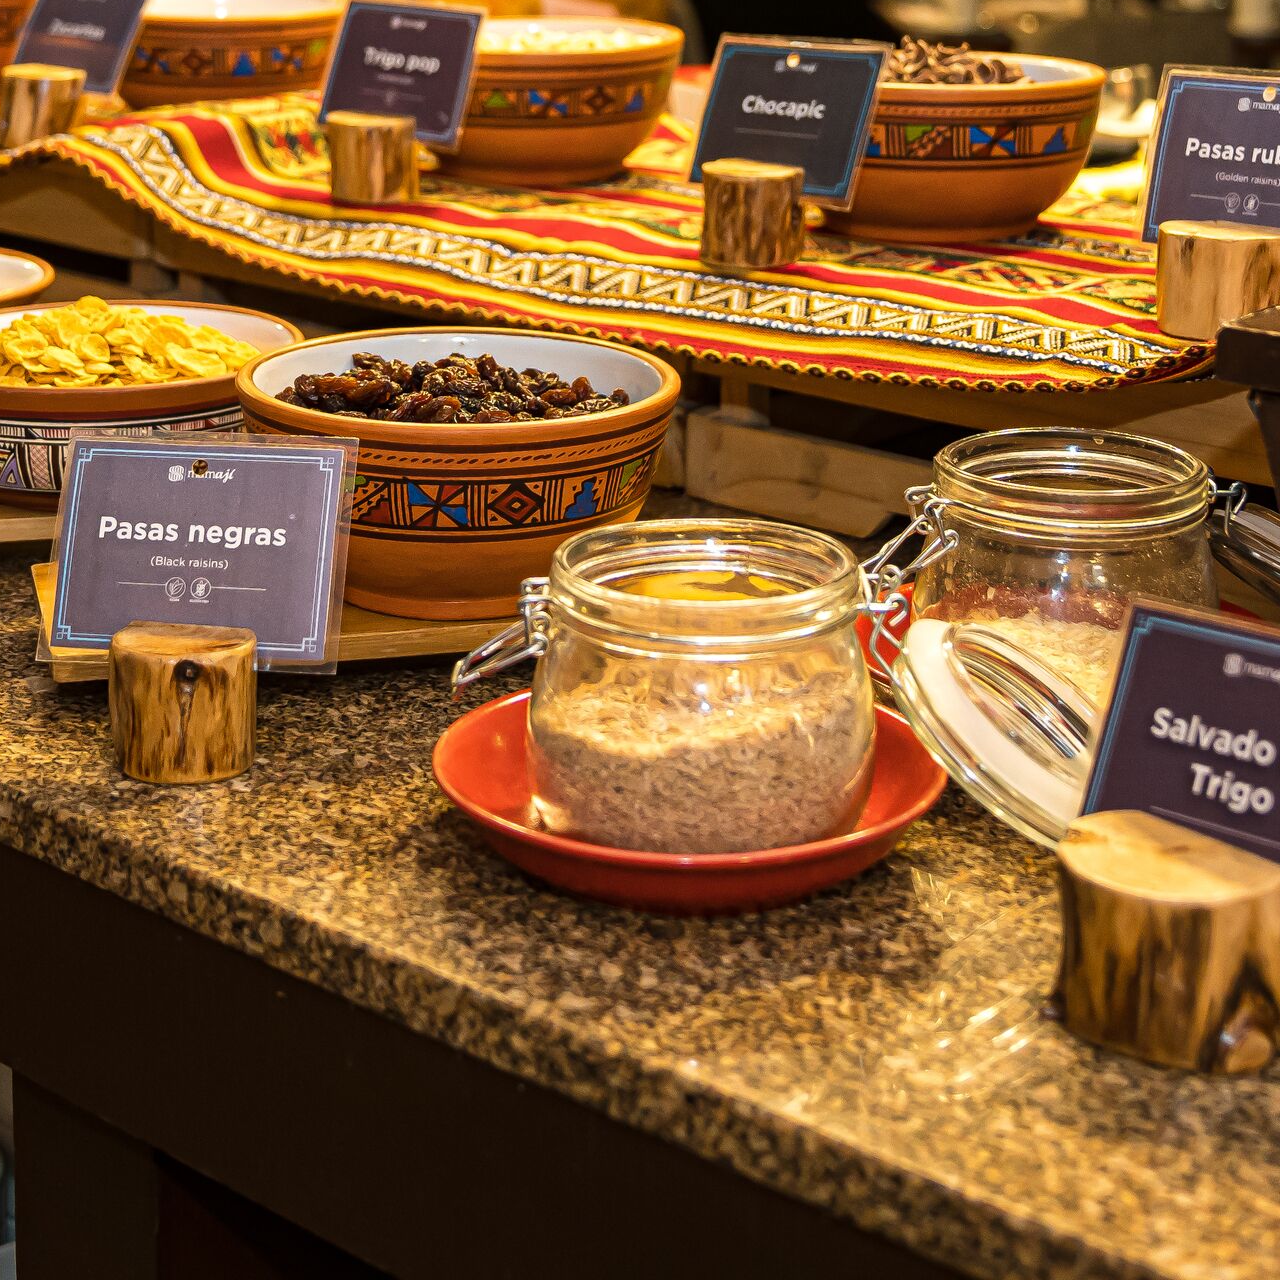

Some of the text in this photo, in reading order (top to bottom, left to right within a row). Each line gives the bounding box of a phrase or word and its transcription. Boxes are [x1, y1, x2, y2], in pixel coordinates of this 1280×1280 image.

[405, 54, 441, 75] pop
[742, 95, 826, 120] Chocapic
[1185, 137, 1245, 162] Pasas
[98, 516, 288, 549] Pasas negras
[150, 555, 229, 570] (Black raisins)
[1150, 706, 1277, 766] Salvado
[1189, 763, 1275, 814] Trigo
